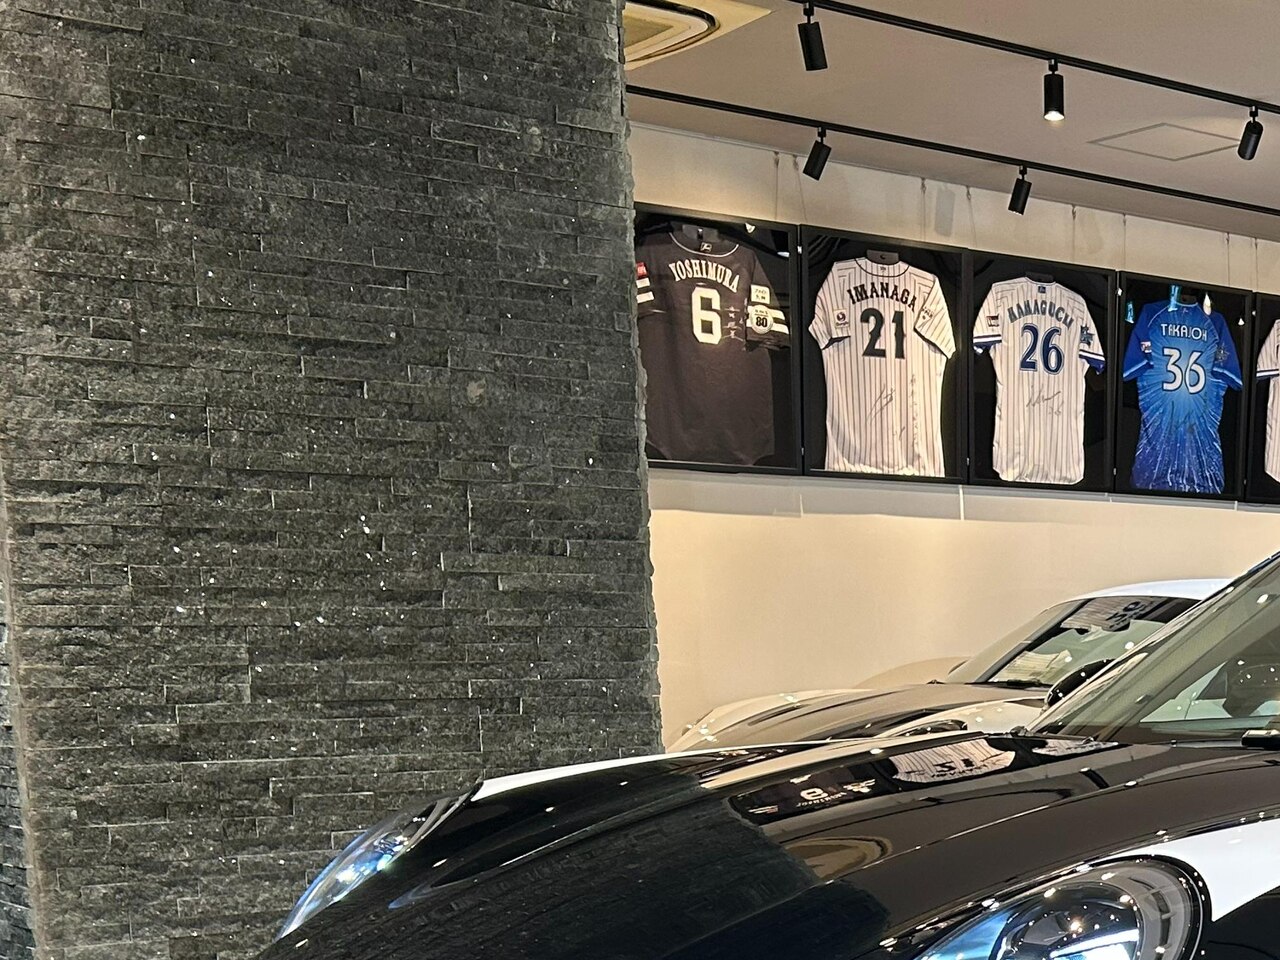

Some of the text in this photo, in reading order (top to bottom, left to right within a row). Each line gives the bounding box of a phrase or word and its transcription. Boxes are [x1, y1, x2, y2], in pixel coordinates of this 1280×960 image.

[669, 259, 740, 293] YOSHIMURA
[691, 286, 722, 345] 6
[847, 282, 917, 313] IMANAGA
[755, 316, 768, 328] 80
[860, 308, 906, 360] 21
[1160, 323, 1208, 342] TAKAJOH
[1019, 323, 1065, 375] 26
[1162, 346, 1207, 395] 36
